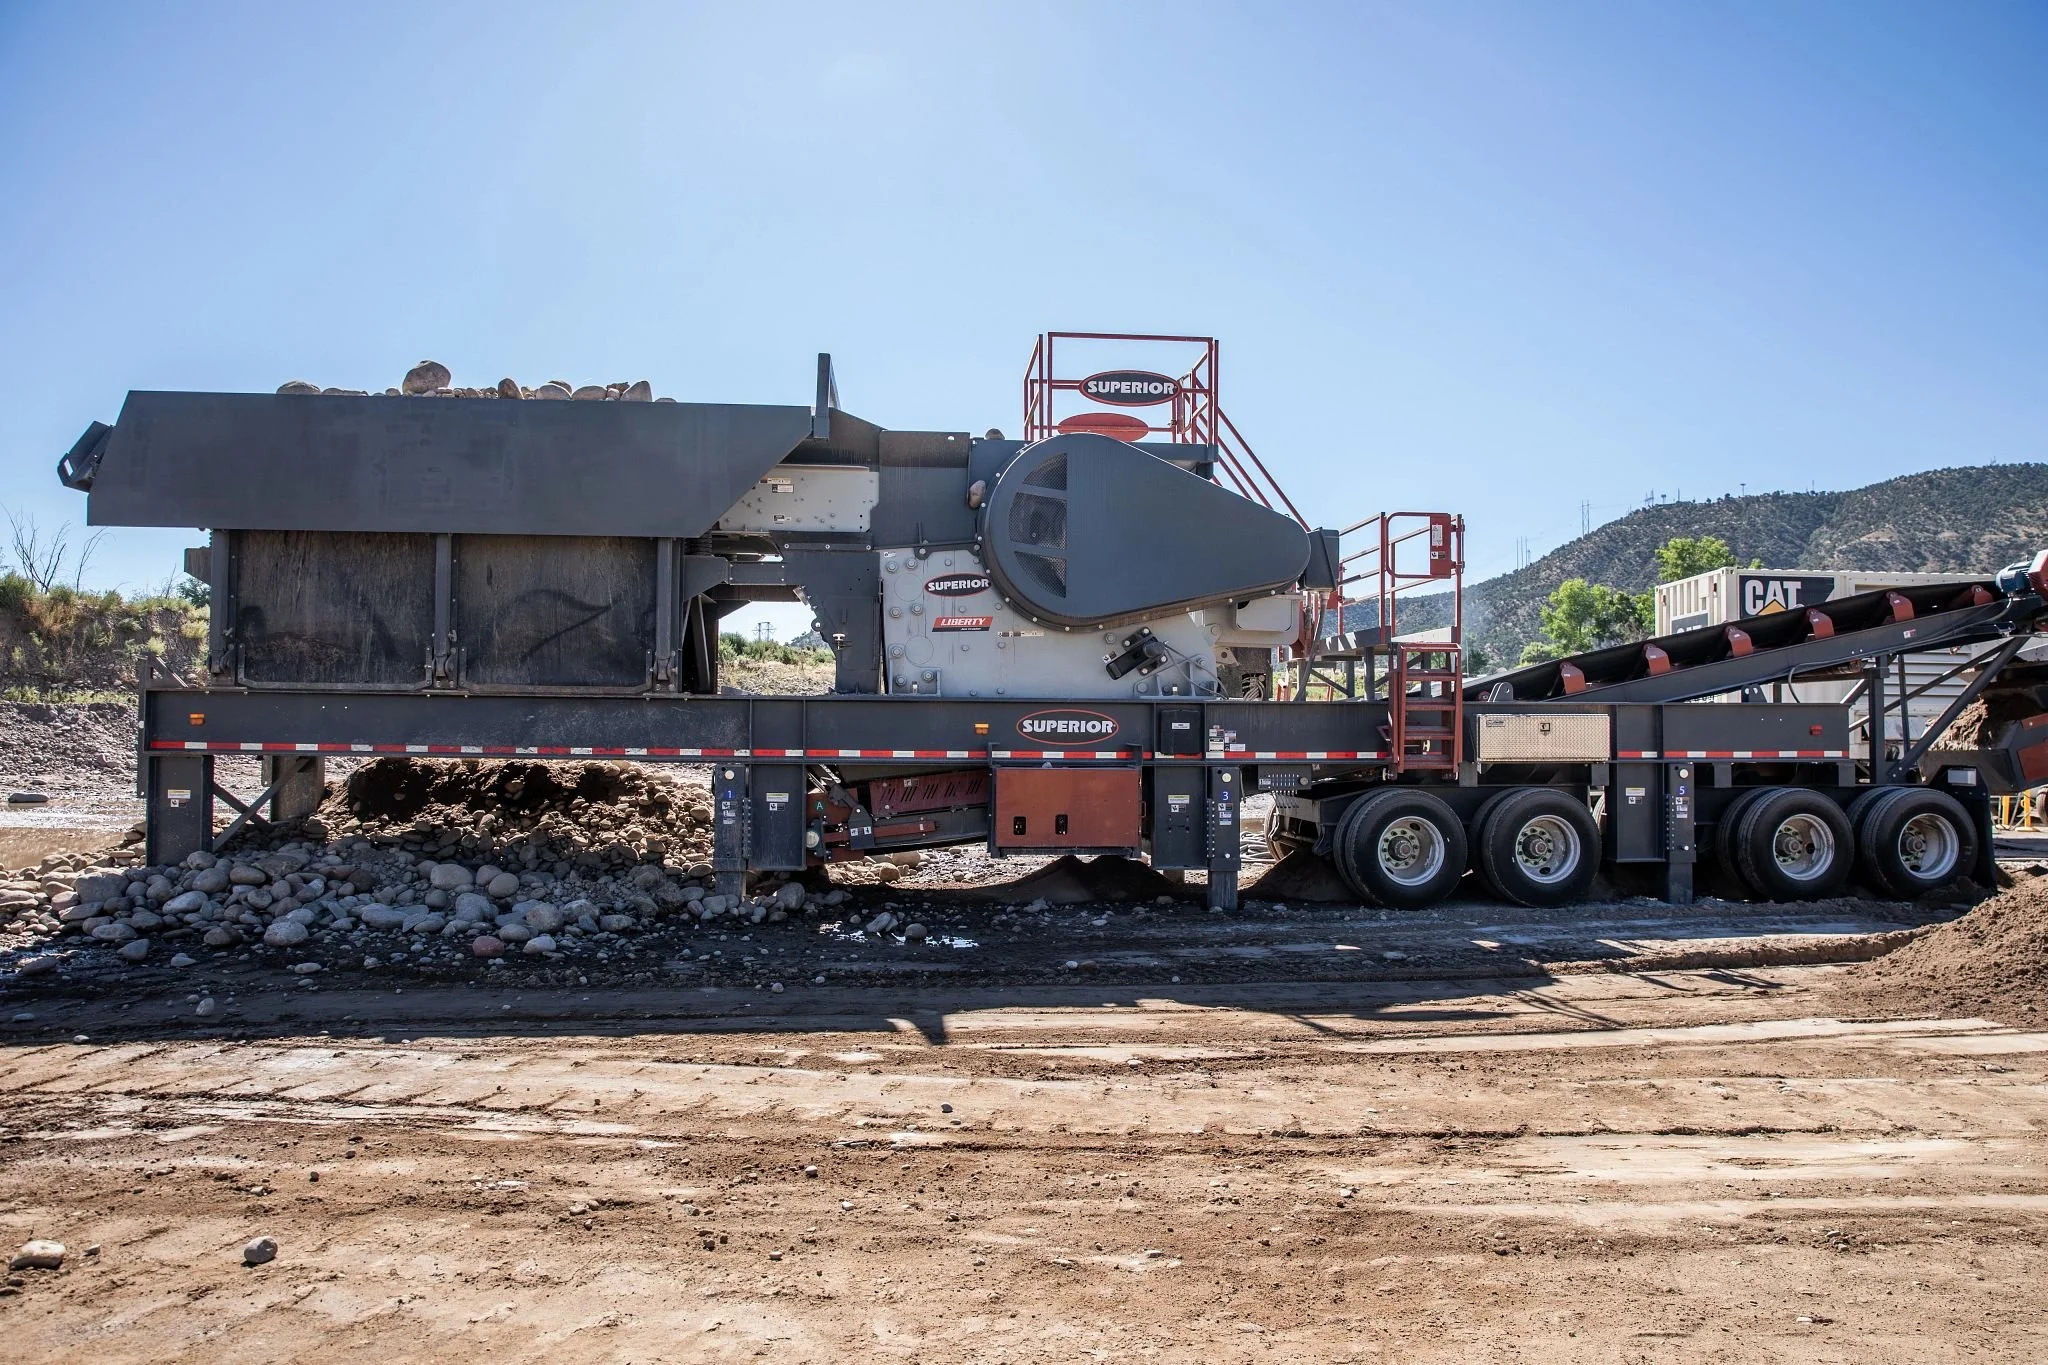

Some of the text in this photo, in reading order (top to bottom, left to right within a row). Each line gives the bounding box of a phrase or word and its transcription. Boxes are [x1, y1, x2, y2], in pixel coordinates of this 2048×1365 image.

[1087, 381, 1174, 394] SUPERIOR
[928, 579, 990, 591] SUPERIOR
[1744, 579, 1802, 616] CAT
[941, 618, 986, 626] LIBERTY
[1022, 719, 1113, 733] SUPERIOR
[1679, 785, 1685, 795] 5
[1222, 791, 1229, 801] 3
[816, 801, 824, 810] A
